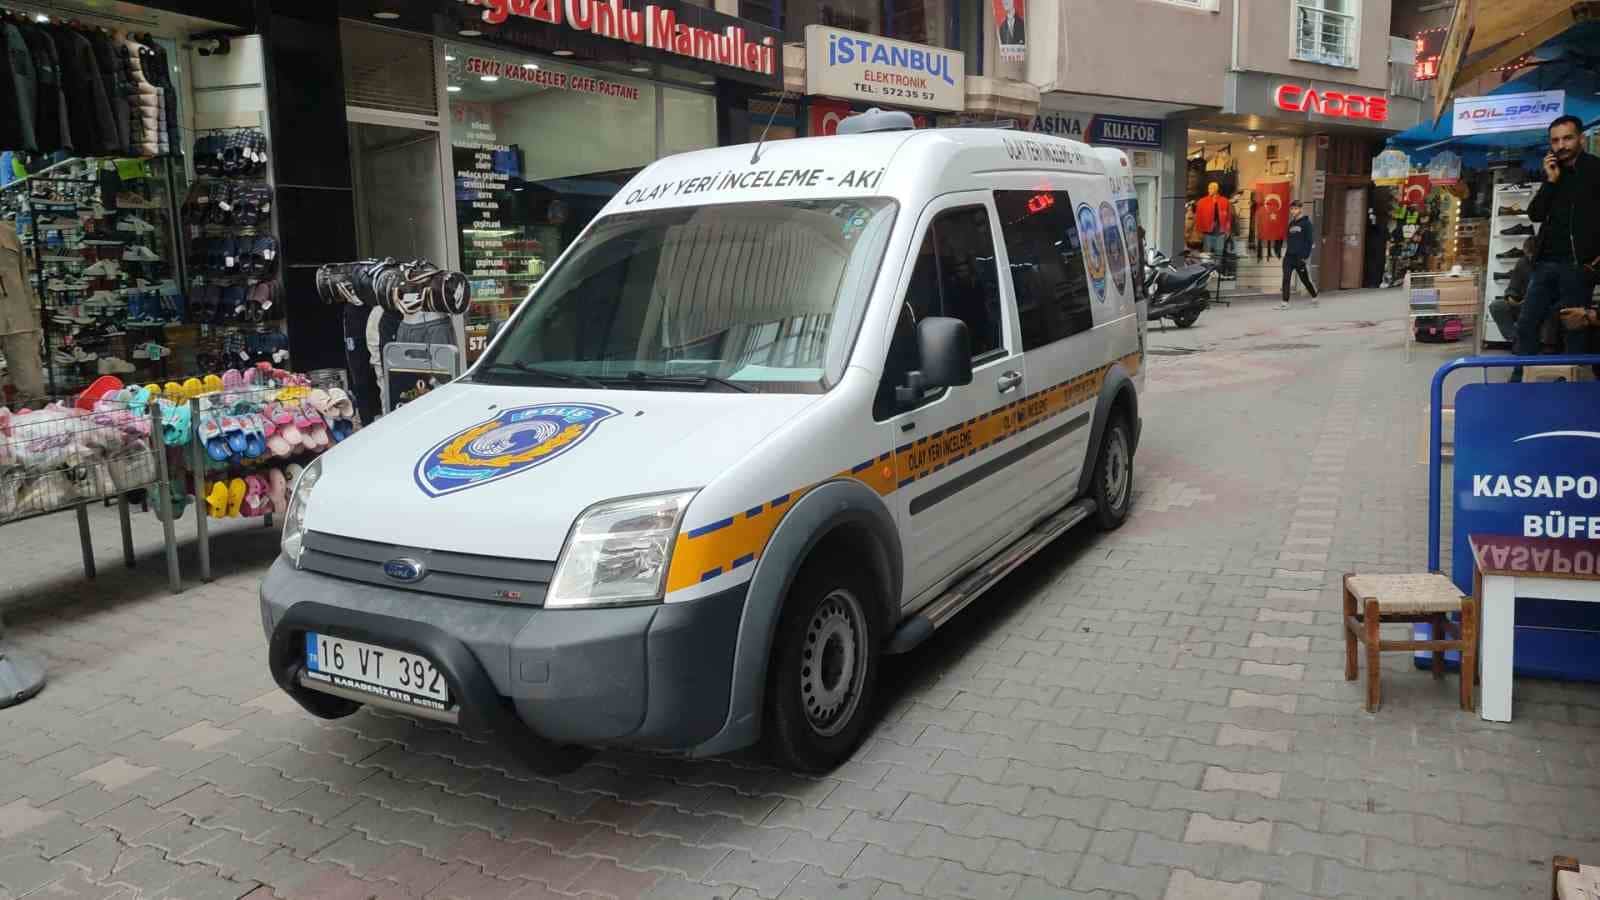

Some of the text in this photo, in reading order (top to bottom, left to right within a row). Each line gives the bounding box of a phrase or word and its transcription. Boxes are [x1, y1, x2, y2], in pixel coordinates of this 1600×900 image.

[646, 4, 775, 75] Mamulleri
[466, 57, 501, 75] SEKİZ
[571, 76, 596, 92] CAFE
[599, 79, 640, 100] PASTANE
[922, 92, 935, 101] 57
[1274, 83, 1388, 122] CADDE
[625, 182, 675, 206] OLAY
[673, 171, 722, 195] YERİ
[718, 168, 824, 190] İNCELEME
[837, 167, 886, 189] AKİ
[1472, 474, 1600, 499] KASAPO
[1523, 510, 1600, 540] BÜFE
[321, 640, 441, 694] 16 VT 392
